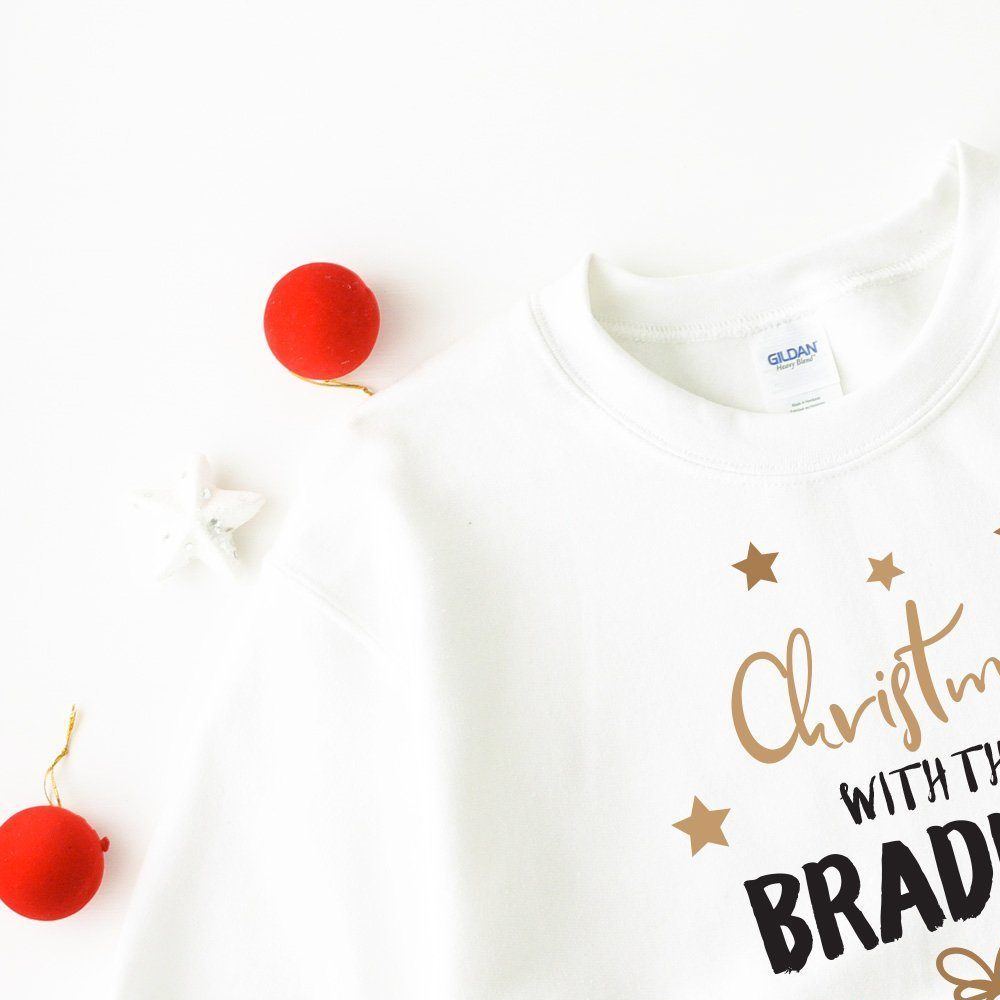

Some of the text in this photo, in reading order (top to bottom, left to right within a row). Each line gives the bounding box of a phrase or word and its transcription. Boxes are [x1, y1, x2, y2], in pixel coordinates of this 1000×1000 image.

[767, 340, 819, 366] GILDAN
[776, 362, 796, 372] Heavy
[839, 757, 950, 826] WITH
